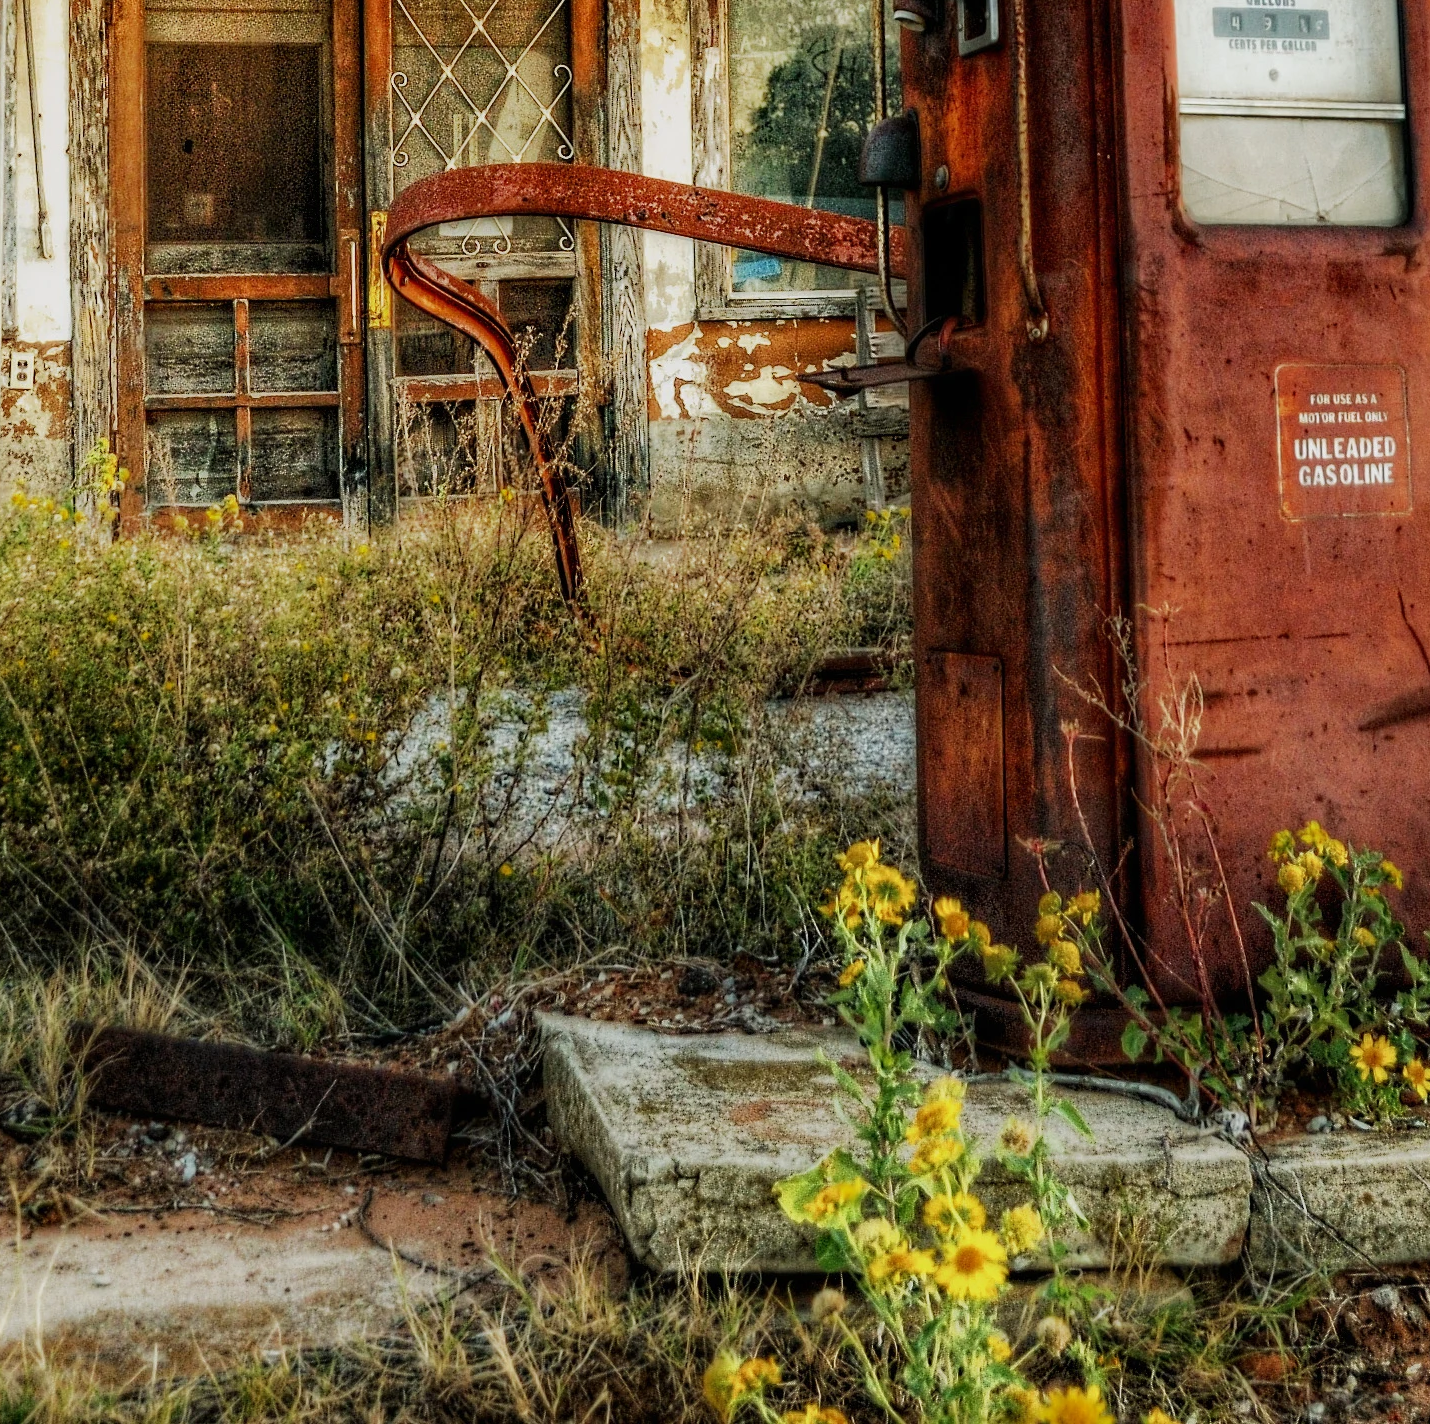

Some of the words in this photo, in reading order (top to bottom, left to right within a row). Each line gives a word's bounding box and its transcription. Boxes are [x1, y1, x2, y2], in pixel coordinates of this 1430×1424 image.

[1229, 39, 1257, 50] CENTS
[1261, 39, 1278, 51] PER
[1282, 40, 1317, 52] GALLON
[1310, 394, 1331, 405] FOR
[1333, 394, 1352, 405] USE
[1355, 394, 1368, 404] AS
[1370, 394, 1378, 404] A
[1299, 412, 1336, 424] MOTOR
[1338, 412, 1363, 423] FUEL
[1365, 411, 1389, 423] ONLY
[1294, 436, 1397, 460] UNLEADED
[1299, 463, 1395, 487] GASOLINE
